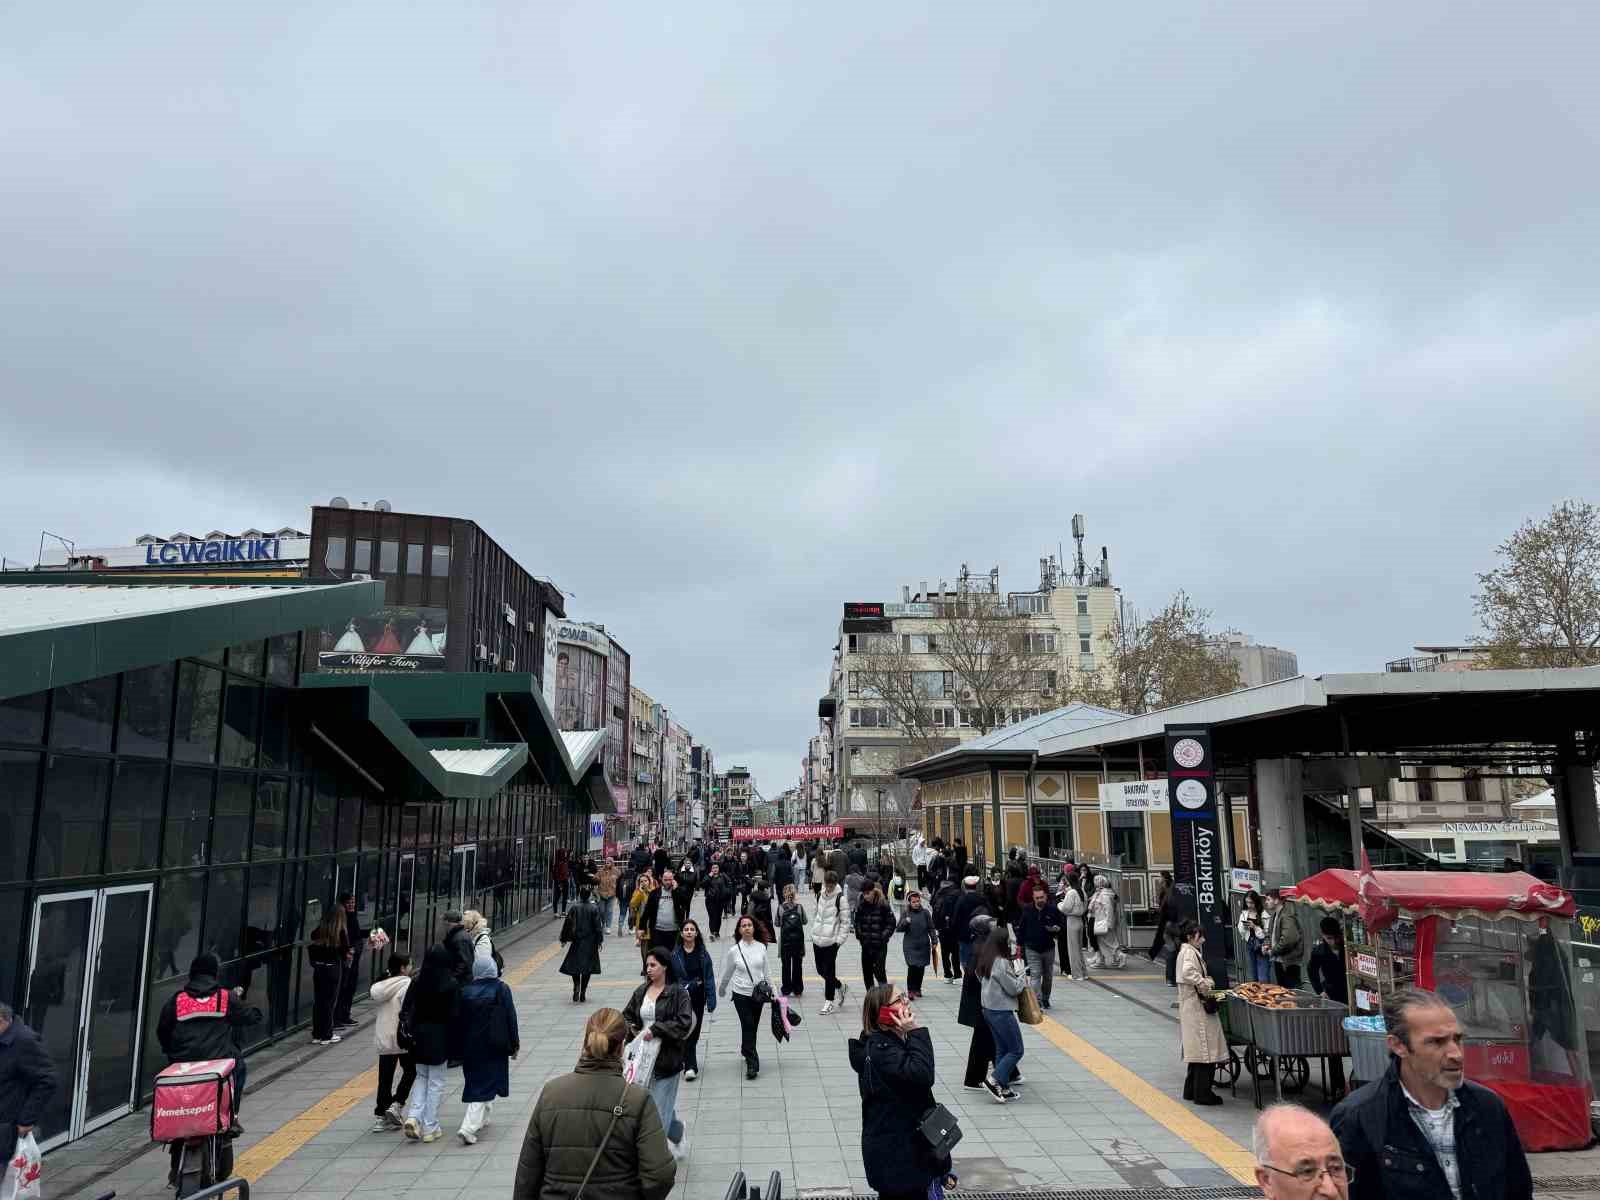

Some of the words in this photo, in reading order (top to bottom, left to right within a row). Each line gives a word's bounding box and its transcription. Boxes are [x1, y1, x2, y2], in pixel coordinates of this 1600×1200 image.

[1444, 822, 1498, 833] NEVADA
[1196, 826, 1214, 905] Bakırköy
[157, 1102, 215, 1119] Yemeksepeti
